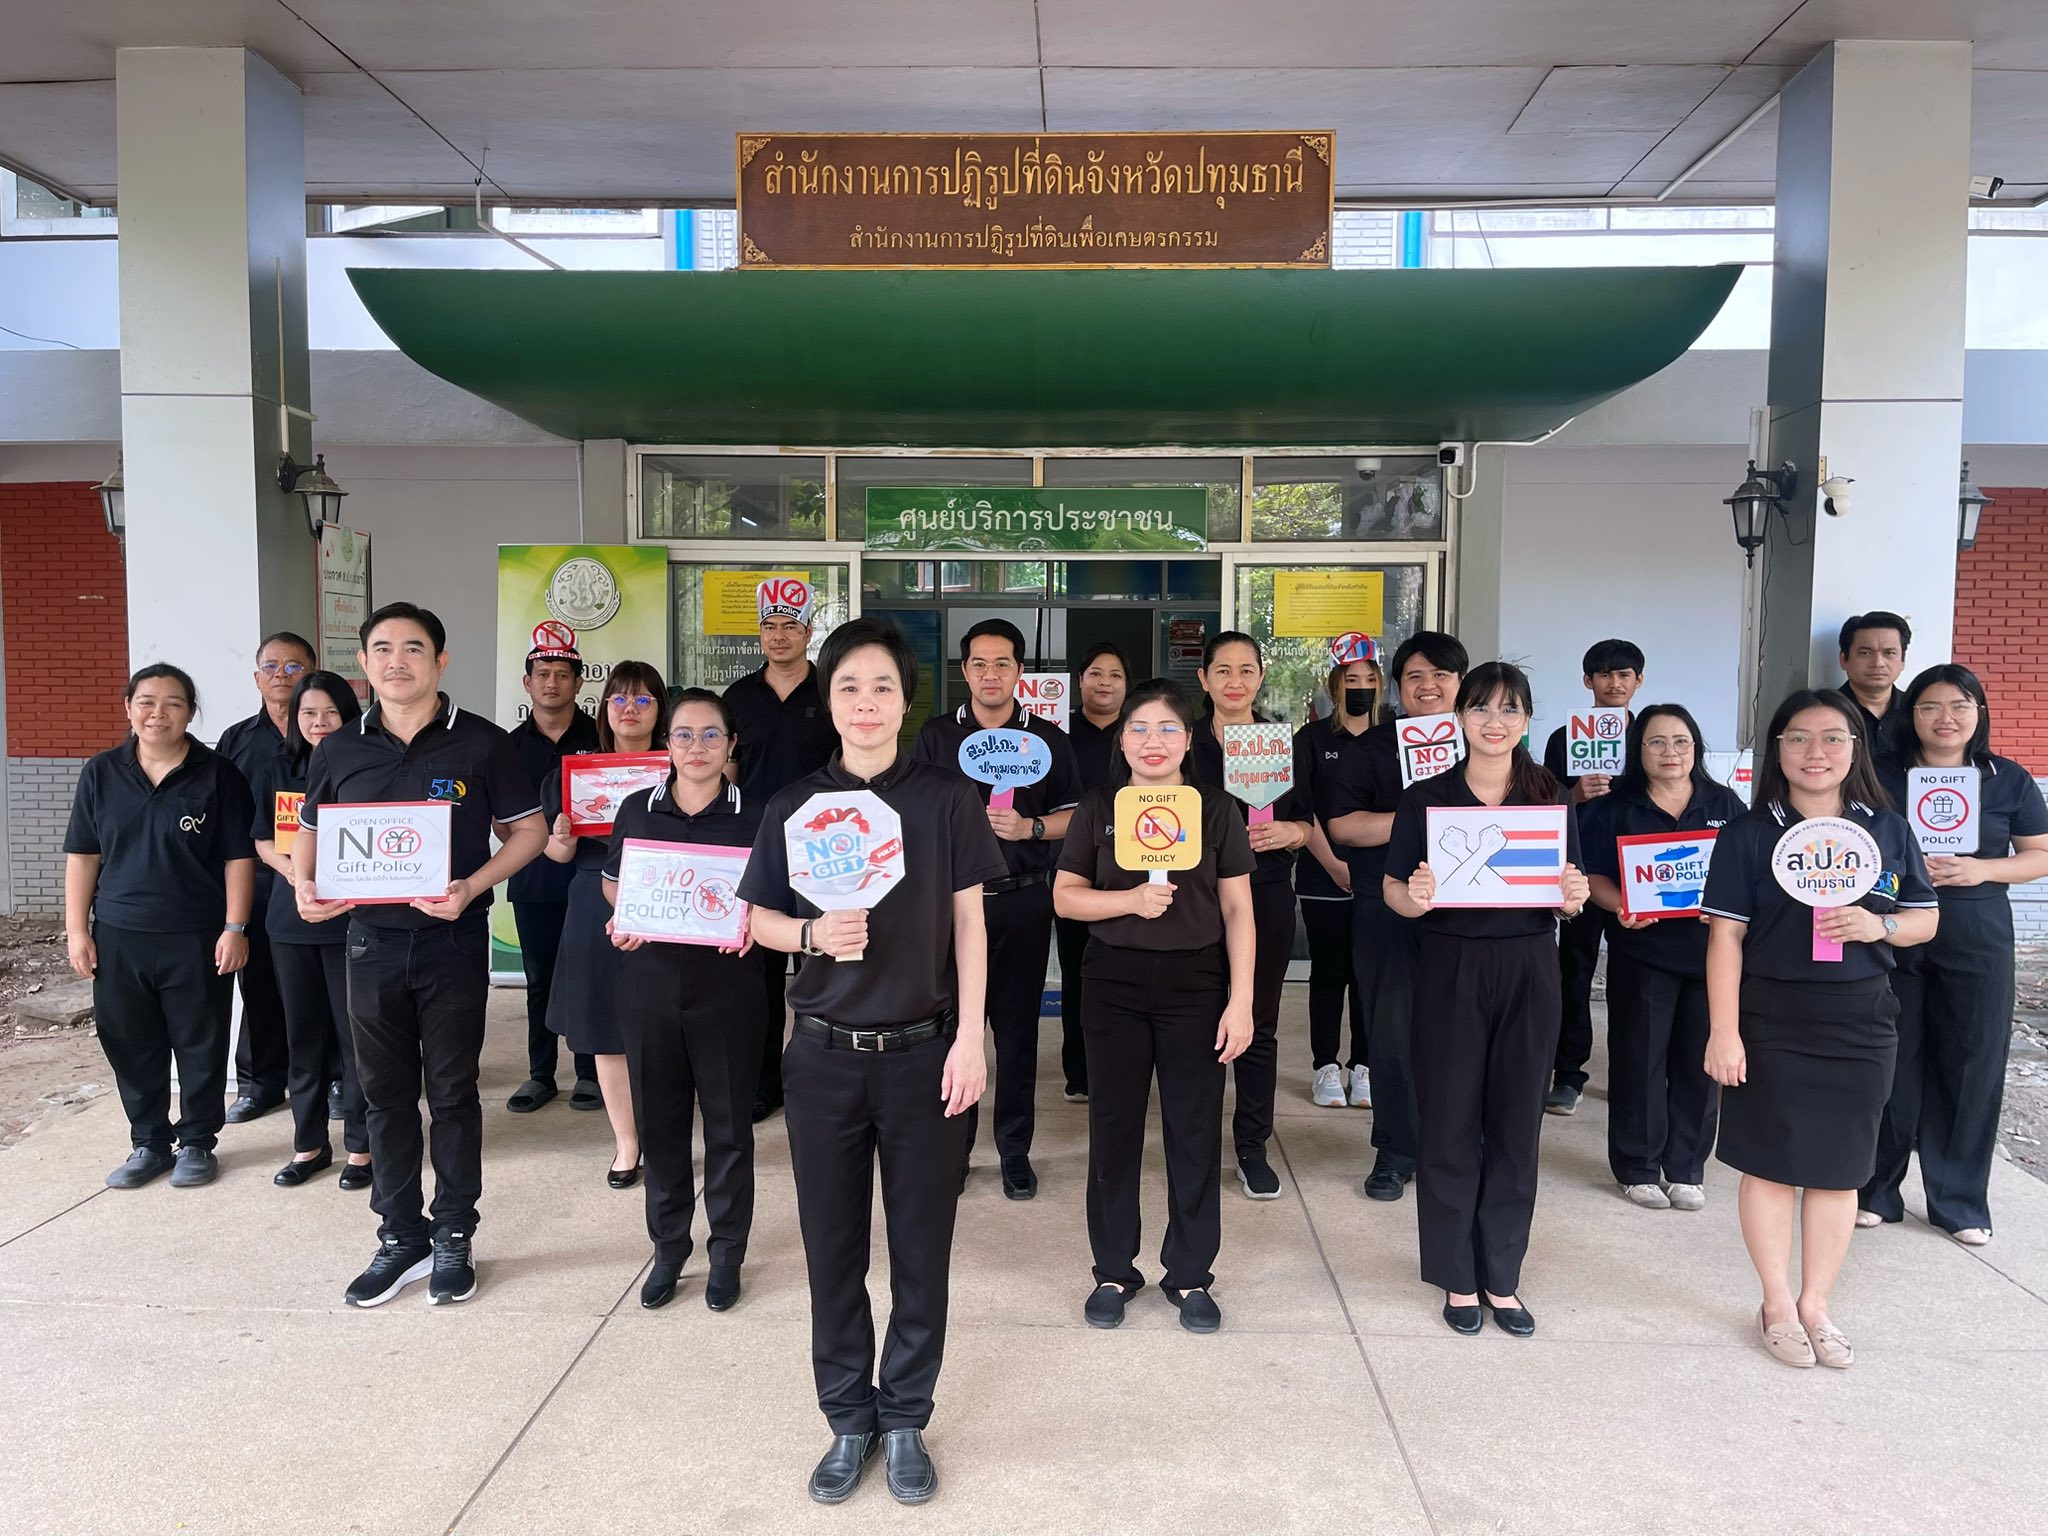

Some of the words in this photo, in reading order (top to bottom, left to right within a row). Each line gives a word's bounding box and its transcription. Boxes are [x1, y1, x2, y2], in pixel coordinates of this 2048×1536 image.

[764, 138, 1303, 210] สำนักงานการปฏิรูปที่ดินจังหวัดปทุมธานี
[849, 215, 1218, 257] สำนักงานการปฏิรูปที่ดินเพื่อเกษตรกรรม
[899, 497, 1174, 541] ศูนย์บริการประชาชน
[966, 735, 1019, 760] ส.ป.ก.
[1226, 735, 1291, 756] ส.ป.ก.
[1570, 740, 1622, 759] GIFT
[1414, 746, 1449, 764] NO
[978, 759, 1041, 780] ปทุมธานี
[1415, 764, 1450, 776] GIFT
[1572, 759, 1622, 770] POLICY
[1228, 766, 1291, 789] ปทุมธานี
[1920, 776, 1937, 784] NO
[1940, 776, 1967, 784] GIFT
[276, 814, 295, 822] GIFT
[349, 818, 377, 826] OPEN
[379, 817, 414, 825] OFFICE
[1922, 836, 1964, 845] POLICY
[337, 861, 368, 874] Gift
[372, 860, 423, 875] Policy
[814, 856, 860, 877] GIFT
[1675, 861, 1704, 872] GIFT
[1787, 846, 1870, 871] ส.ป.ก.
[661, 867, 695, 887] NO
[1676, 870, 1710, 881] POLIC
[1797, 875, 1856, 893] ปทุมธานี
[651, 888, 692, 904] GIFT
[625, 903, 690, 920] POLICY
